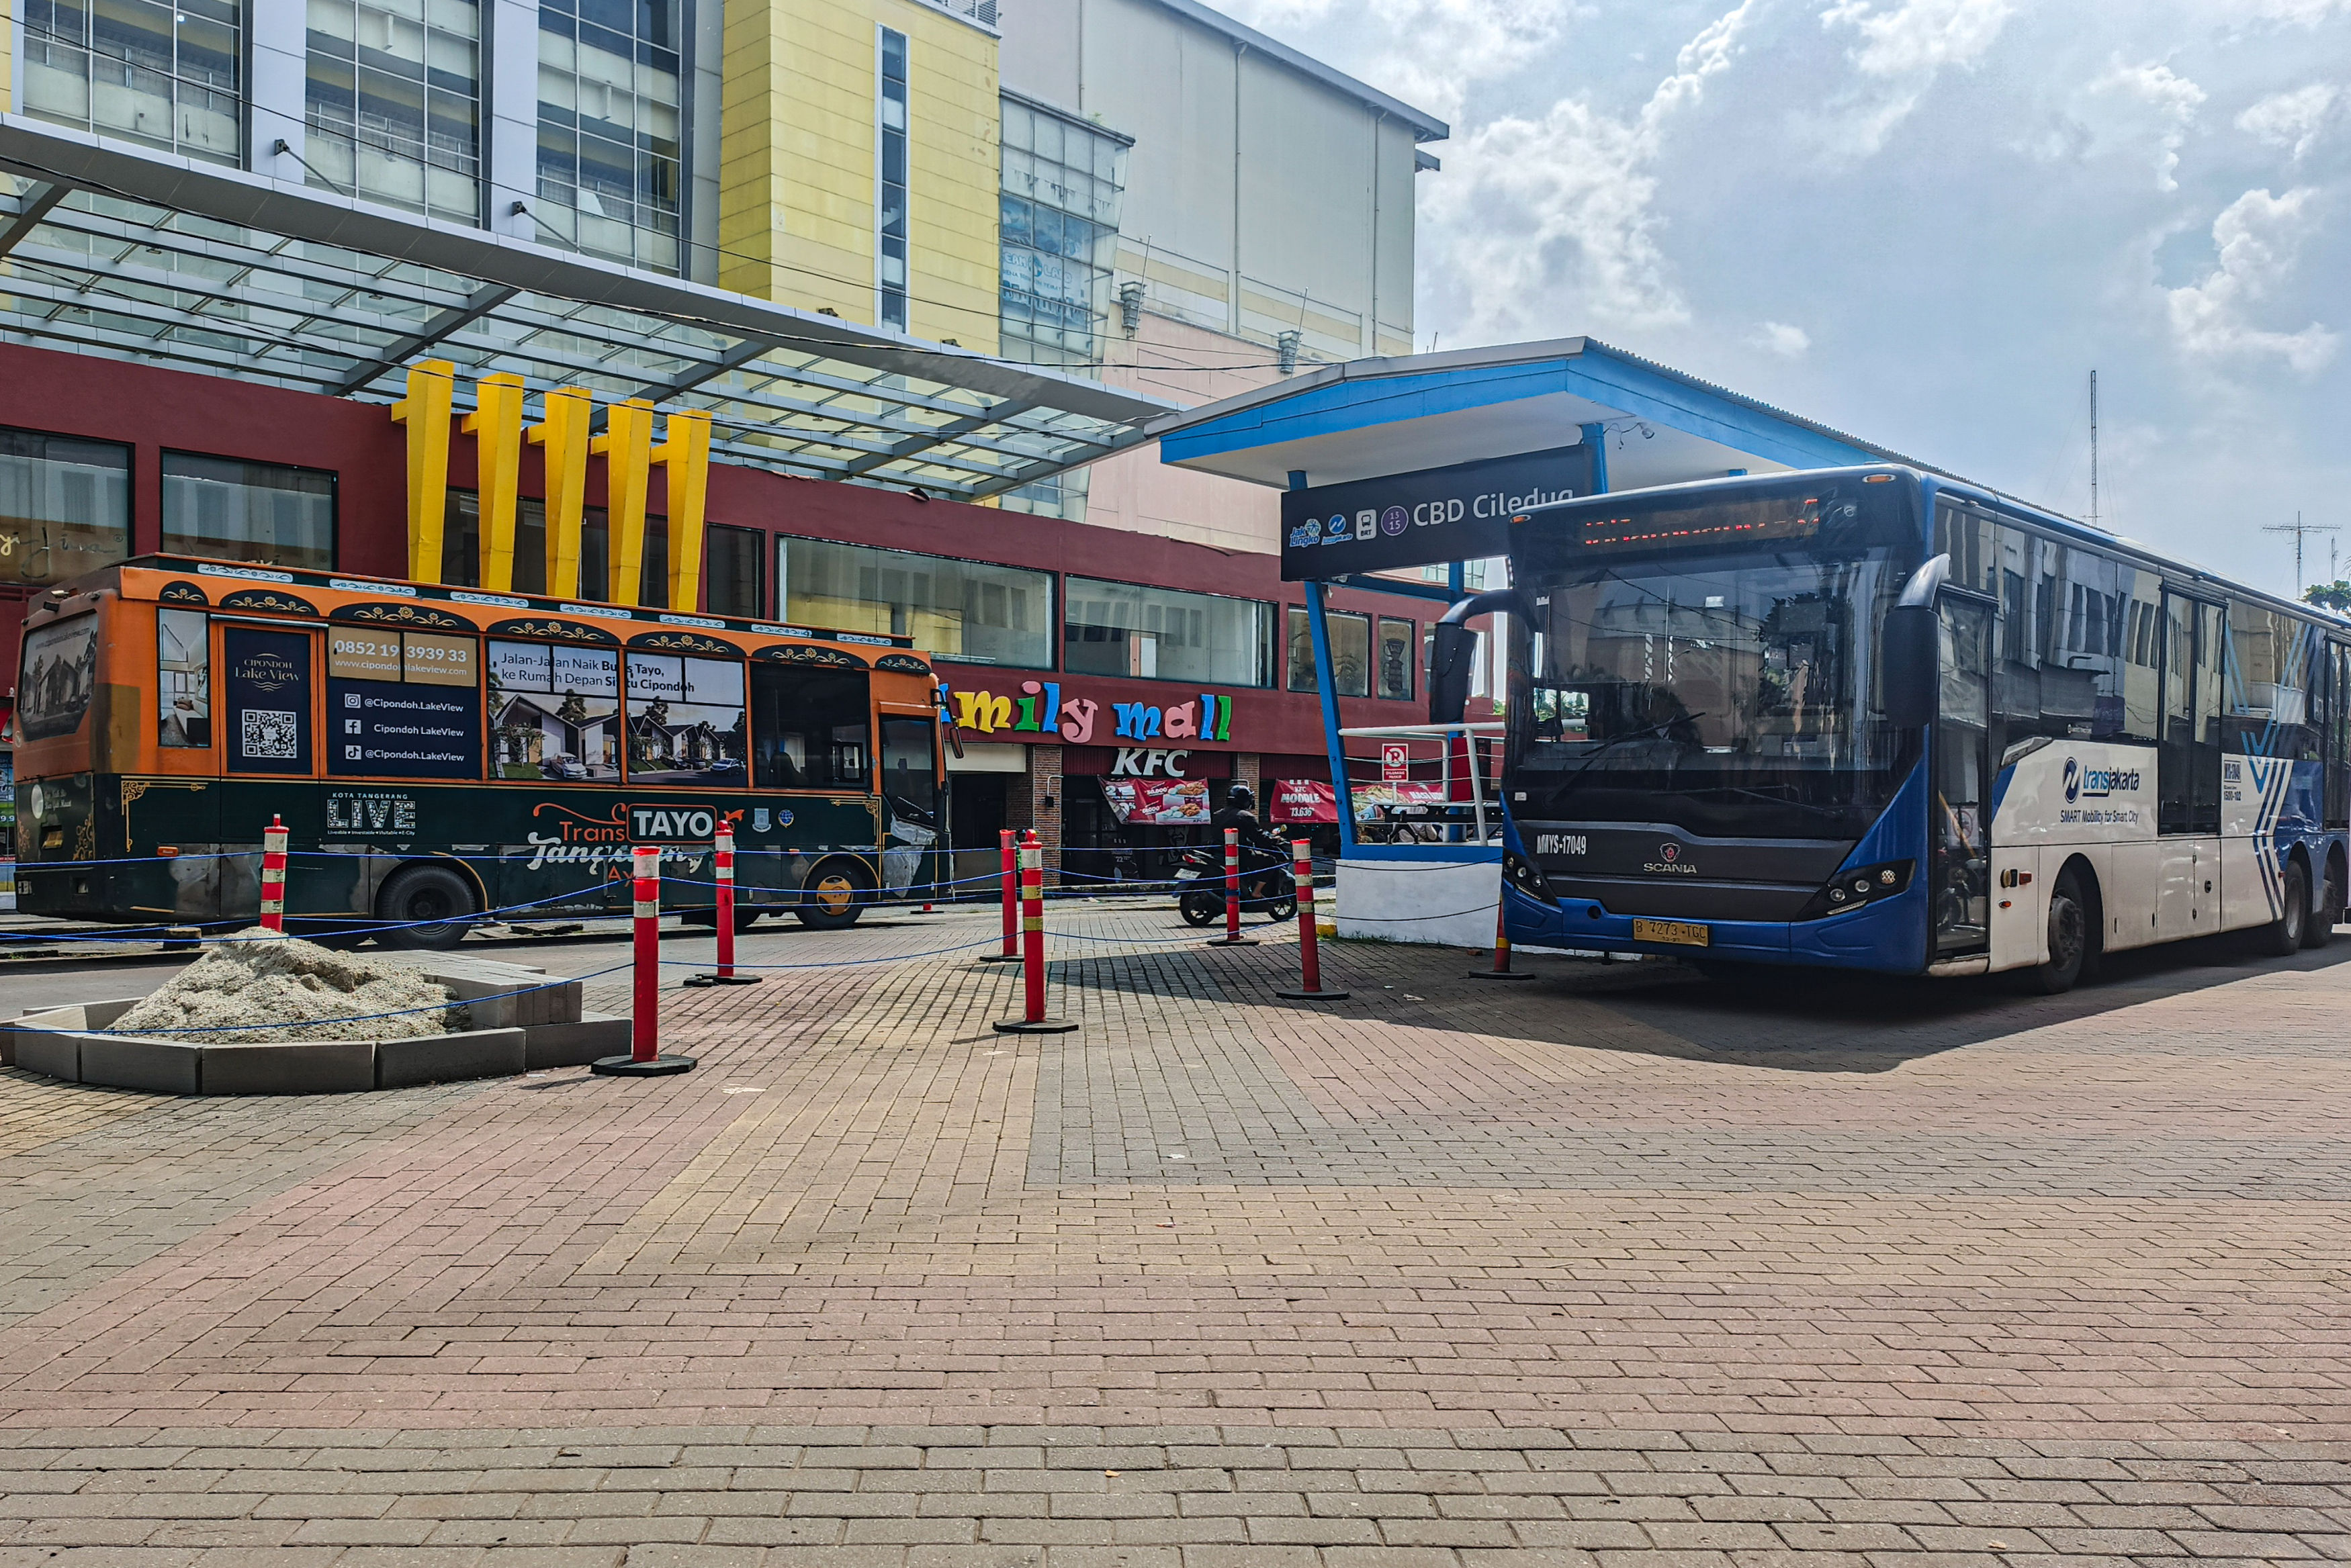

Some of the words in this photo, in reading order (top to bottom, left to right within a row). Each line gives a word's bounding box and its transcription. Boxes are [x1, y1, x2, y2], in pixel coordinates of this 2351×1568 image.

[1413, 498, 1464, 526] CBD
[1291, 526, 1306, 537] Jak
[1389, 520, 1401, 531] 15
[1290, 535, 1320, 547] Lingko
[335, 640, 376, 656] 0852
[380, 644, 400, 657] 19
[406, 646, 445, 660] 3939
[448, 649, 467, 662] 33
[244, 659, 292, 669] CIPONDOH
[501, 653, 570, 668] Jalan-Jaan
[572, 658, 599, 670] Naik
[635, 663, 664, 677] Tayo,
[236, 667, 266, 679] Lake
[269, 670, 300, 681] View
[502, 668, 516, 680] ke
[519, 670, 562, 683] Rumah
[565, 673, 603, 686] Depan
[365, 698, 463, 712] @Cipondoh.LakeView
[1112, 694, 1233, 741] mall
[374, 724, 418, 735] Cipondoh
[365, 749, 465, 762] @Cipondoh.LakeView
[1111, 747, 1188, 778] KFC
[2083, 765, 2140, 794] transjakarta
[327, 799, 416, 829] LIVE
[2060, 810, 2081, 823] SMART
[2104, 810, 2113, 823] for
[2113, 810, 2128, 823] Smart
[560, 821, 625, 842] Trans
[633, 811, 713, 837] TAYO
[608, 865, 635, 888] Ay
[1643, 863, 1697, 874] SCANIA
[1636, 921, 1643, 933] B
[1650, 922, 1678, 936] 7273
[1685, 925, 1706, 939] TGC
